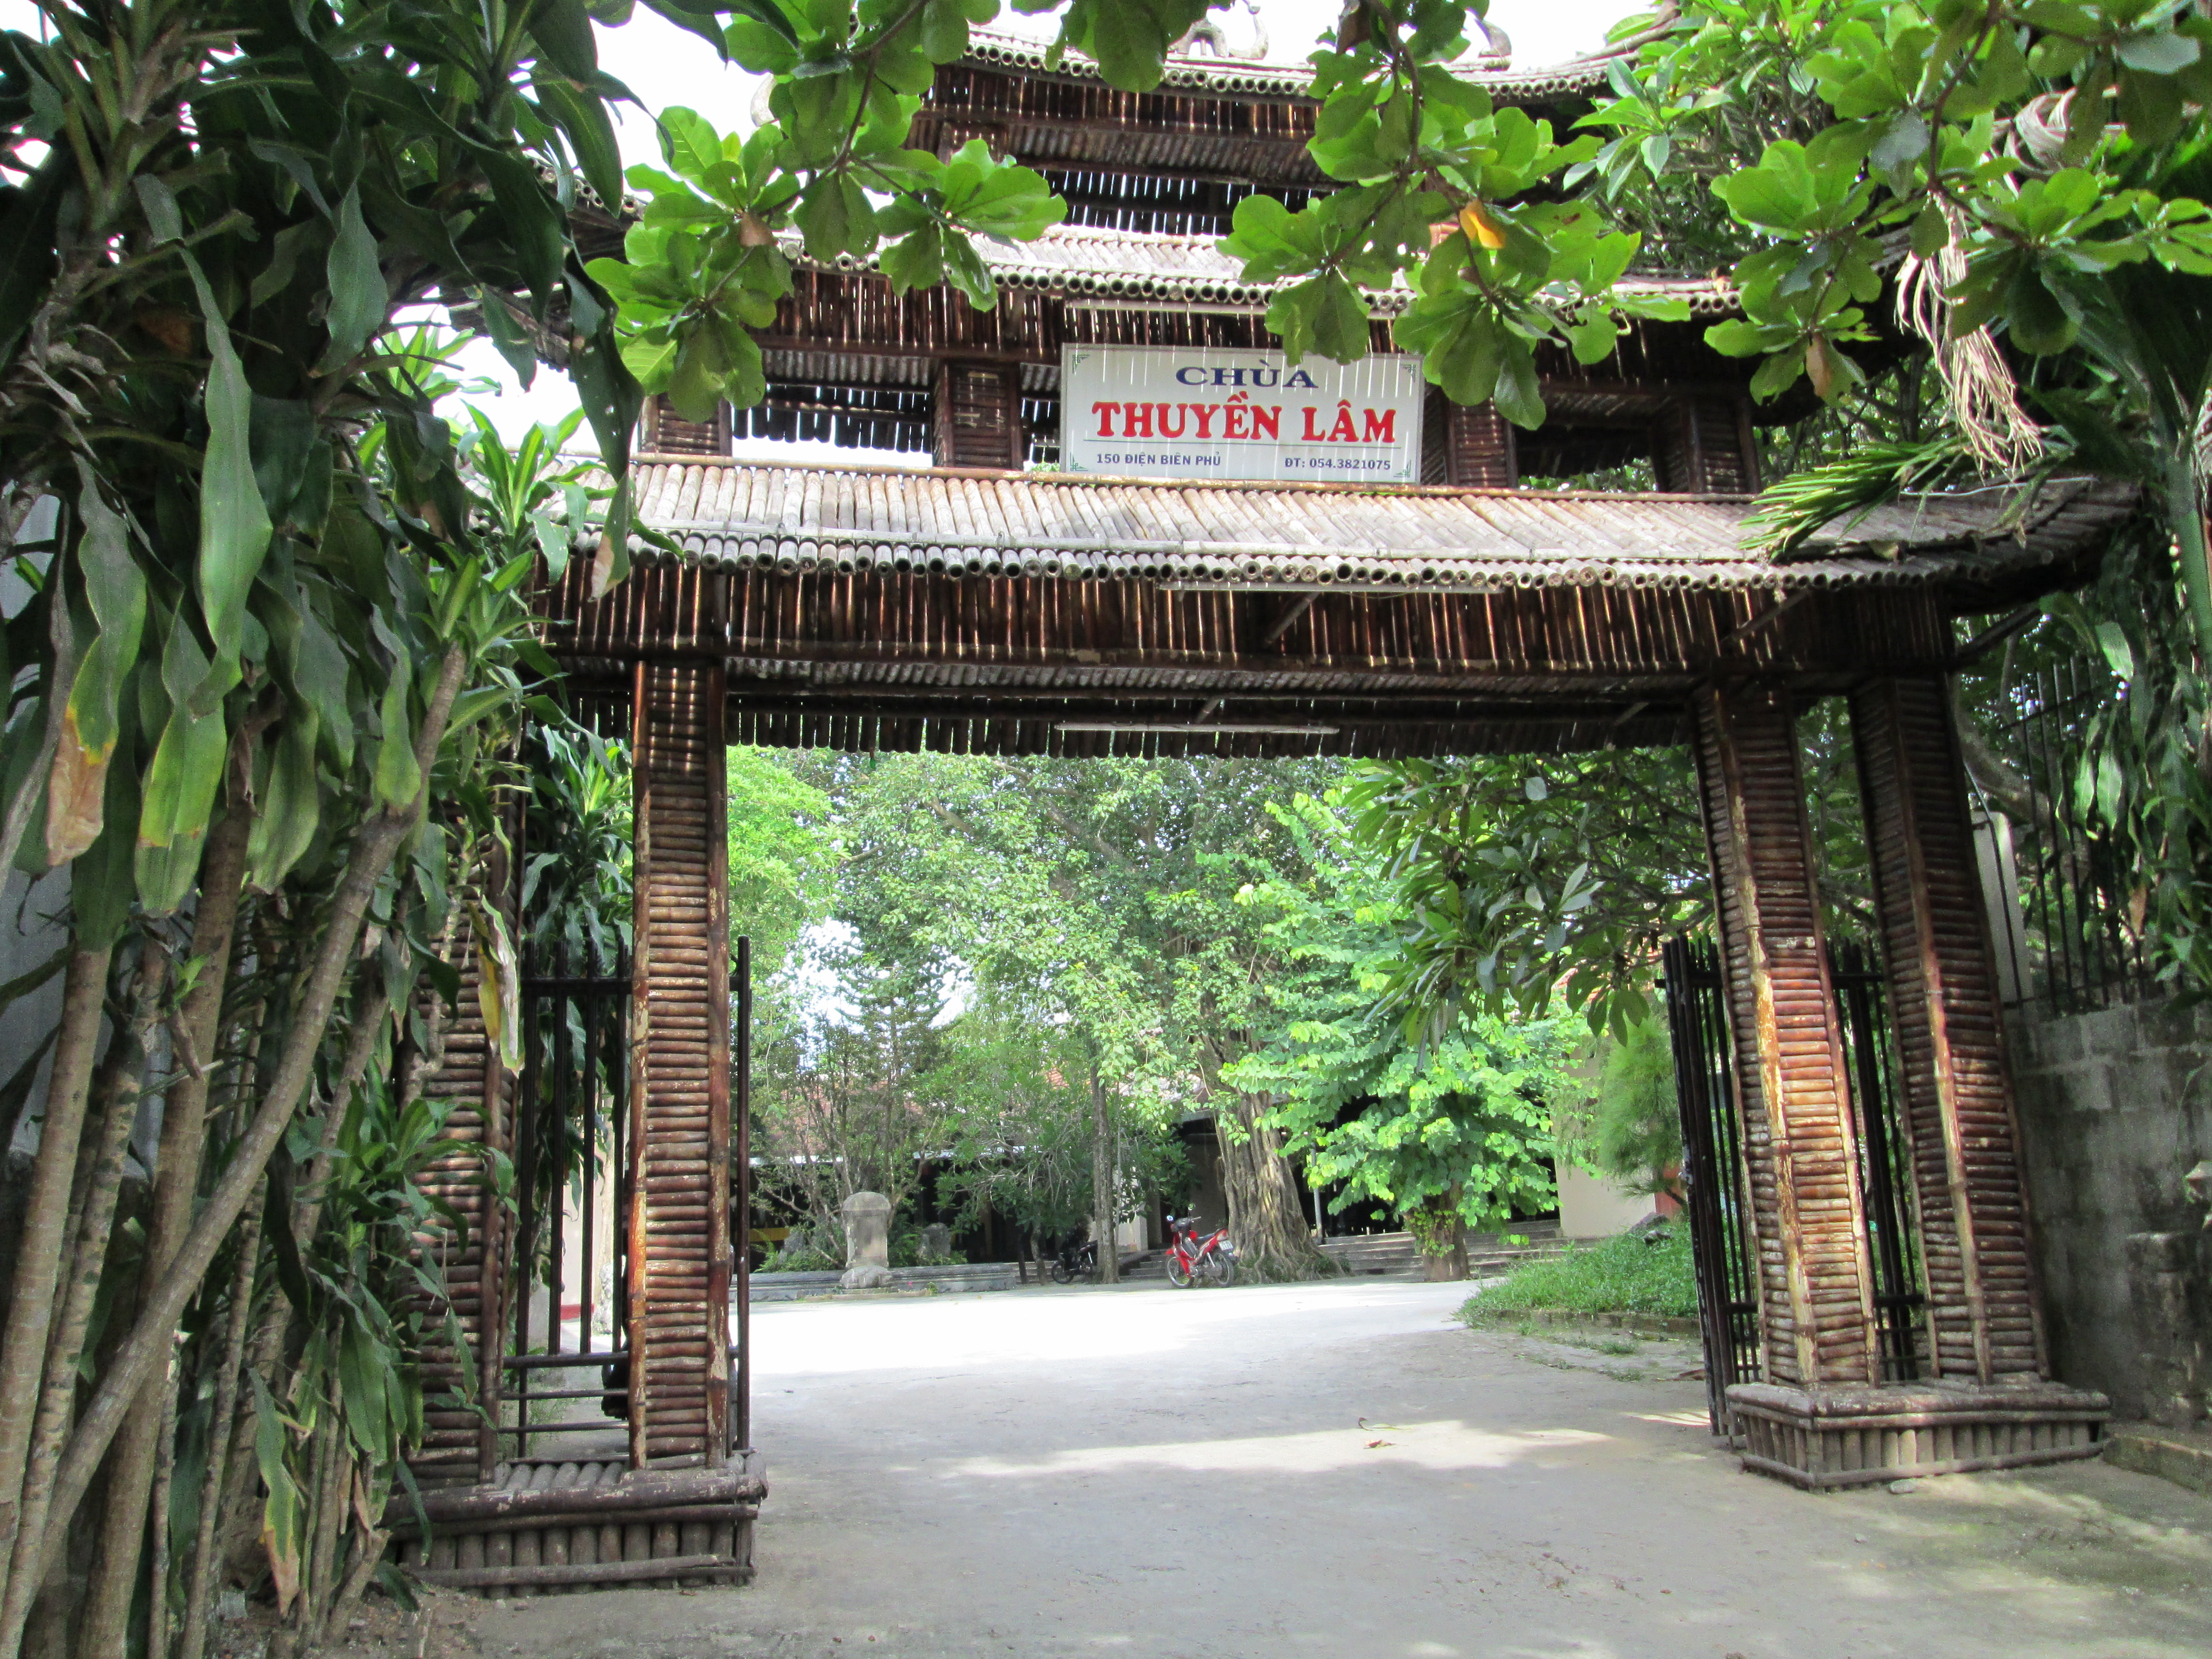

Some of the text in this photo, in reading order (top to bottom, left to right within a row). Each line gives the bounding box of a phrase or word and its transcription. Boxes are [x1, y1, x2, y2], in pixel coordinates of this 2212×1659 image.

[1176, 360, 1318, 388] CHÙA
[1092, 390, 1395, 442] THUYỀN LÂM
[1097, 451, 1221, 467] 150 ĐIỆN BIÊN PHỦ
[1285, 458, 1391, 470] ĐT: 054.3821075
